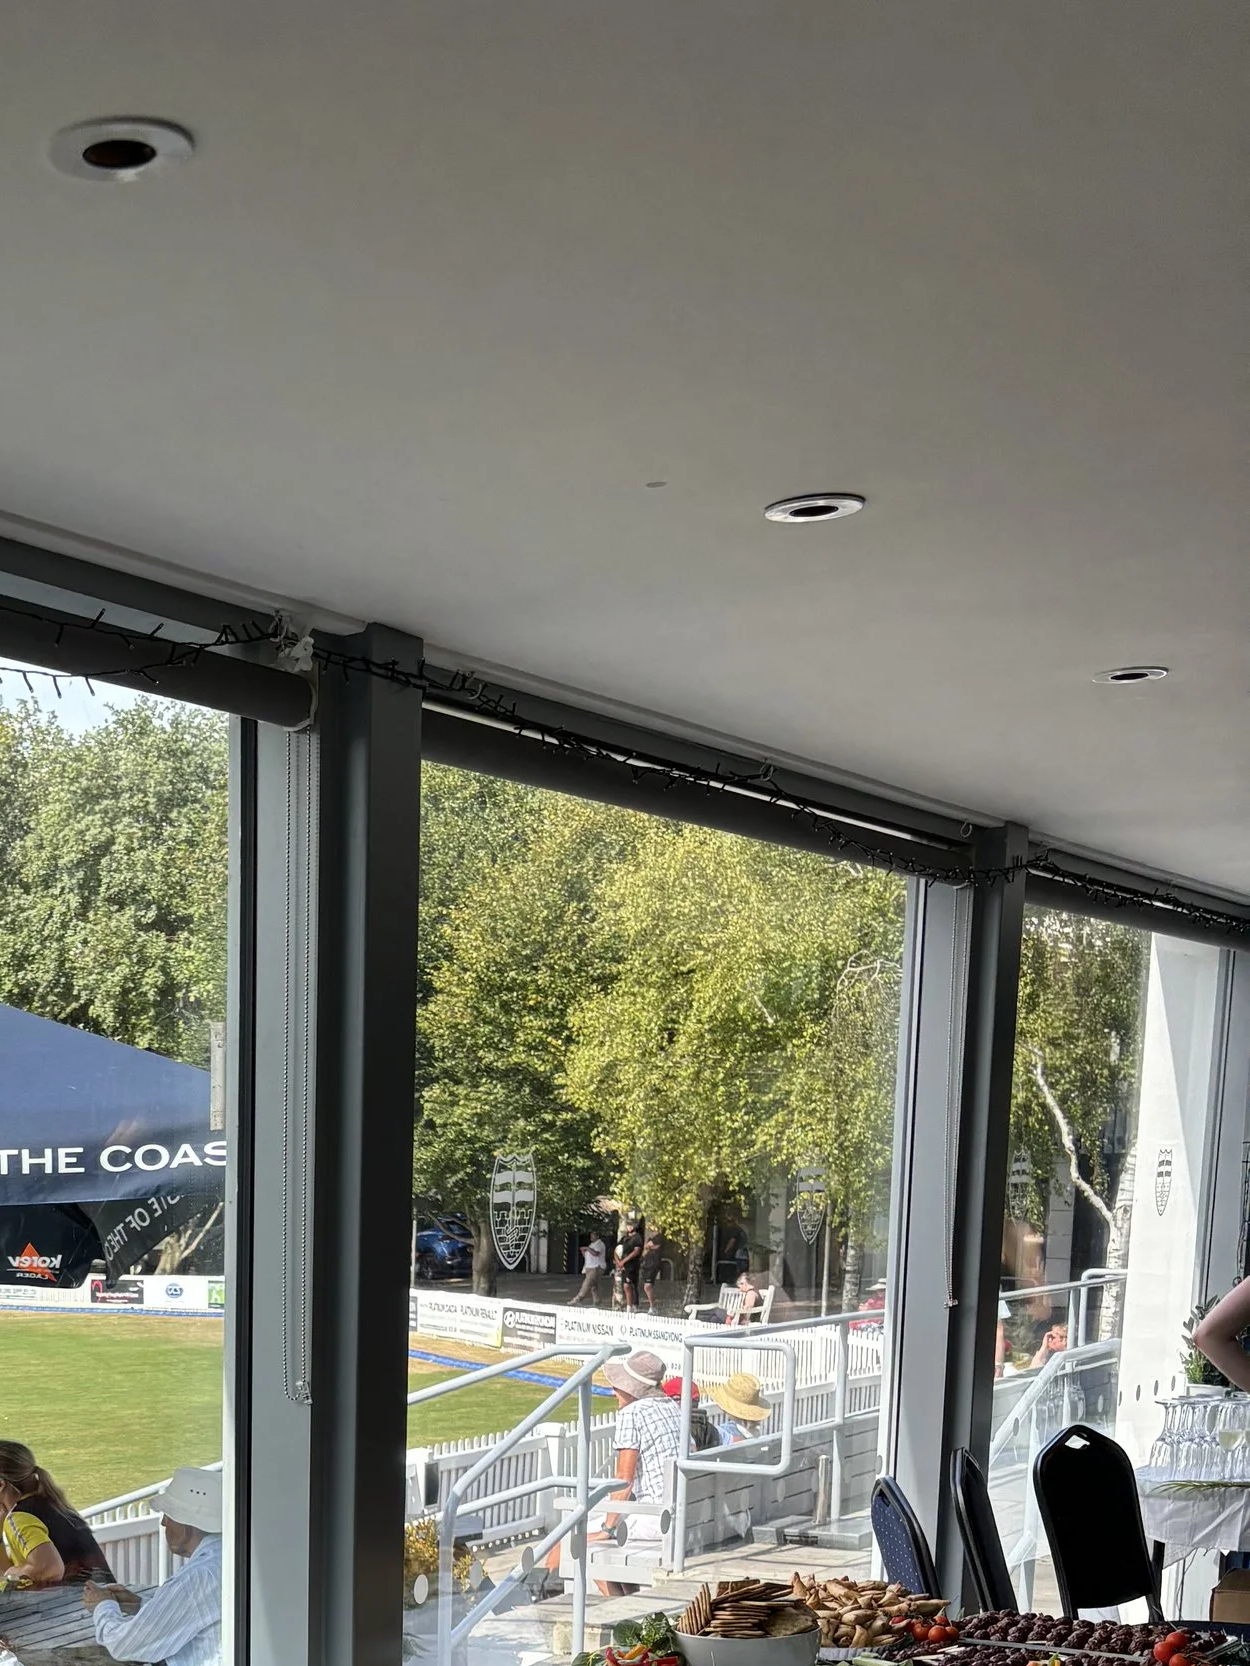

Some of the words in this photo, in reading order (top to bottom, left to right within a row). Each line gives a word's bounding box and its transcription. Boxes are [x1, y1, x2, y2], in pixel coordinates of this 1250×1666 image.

[564, 1320, 591, 1334] PLATINUM
[591, 1324, 614, 1336] NISSAN
[629, 1326, 652, 1339] PLATINUM
[652, 1329, 683, 1343] SSANGYONG
